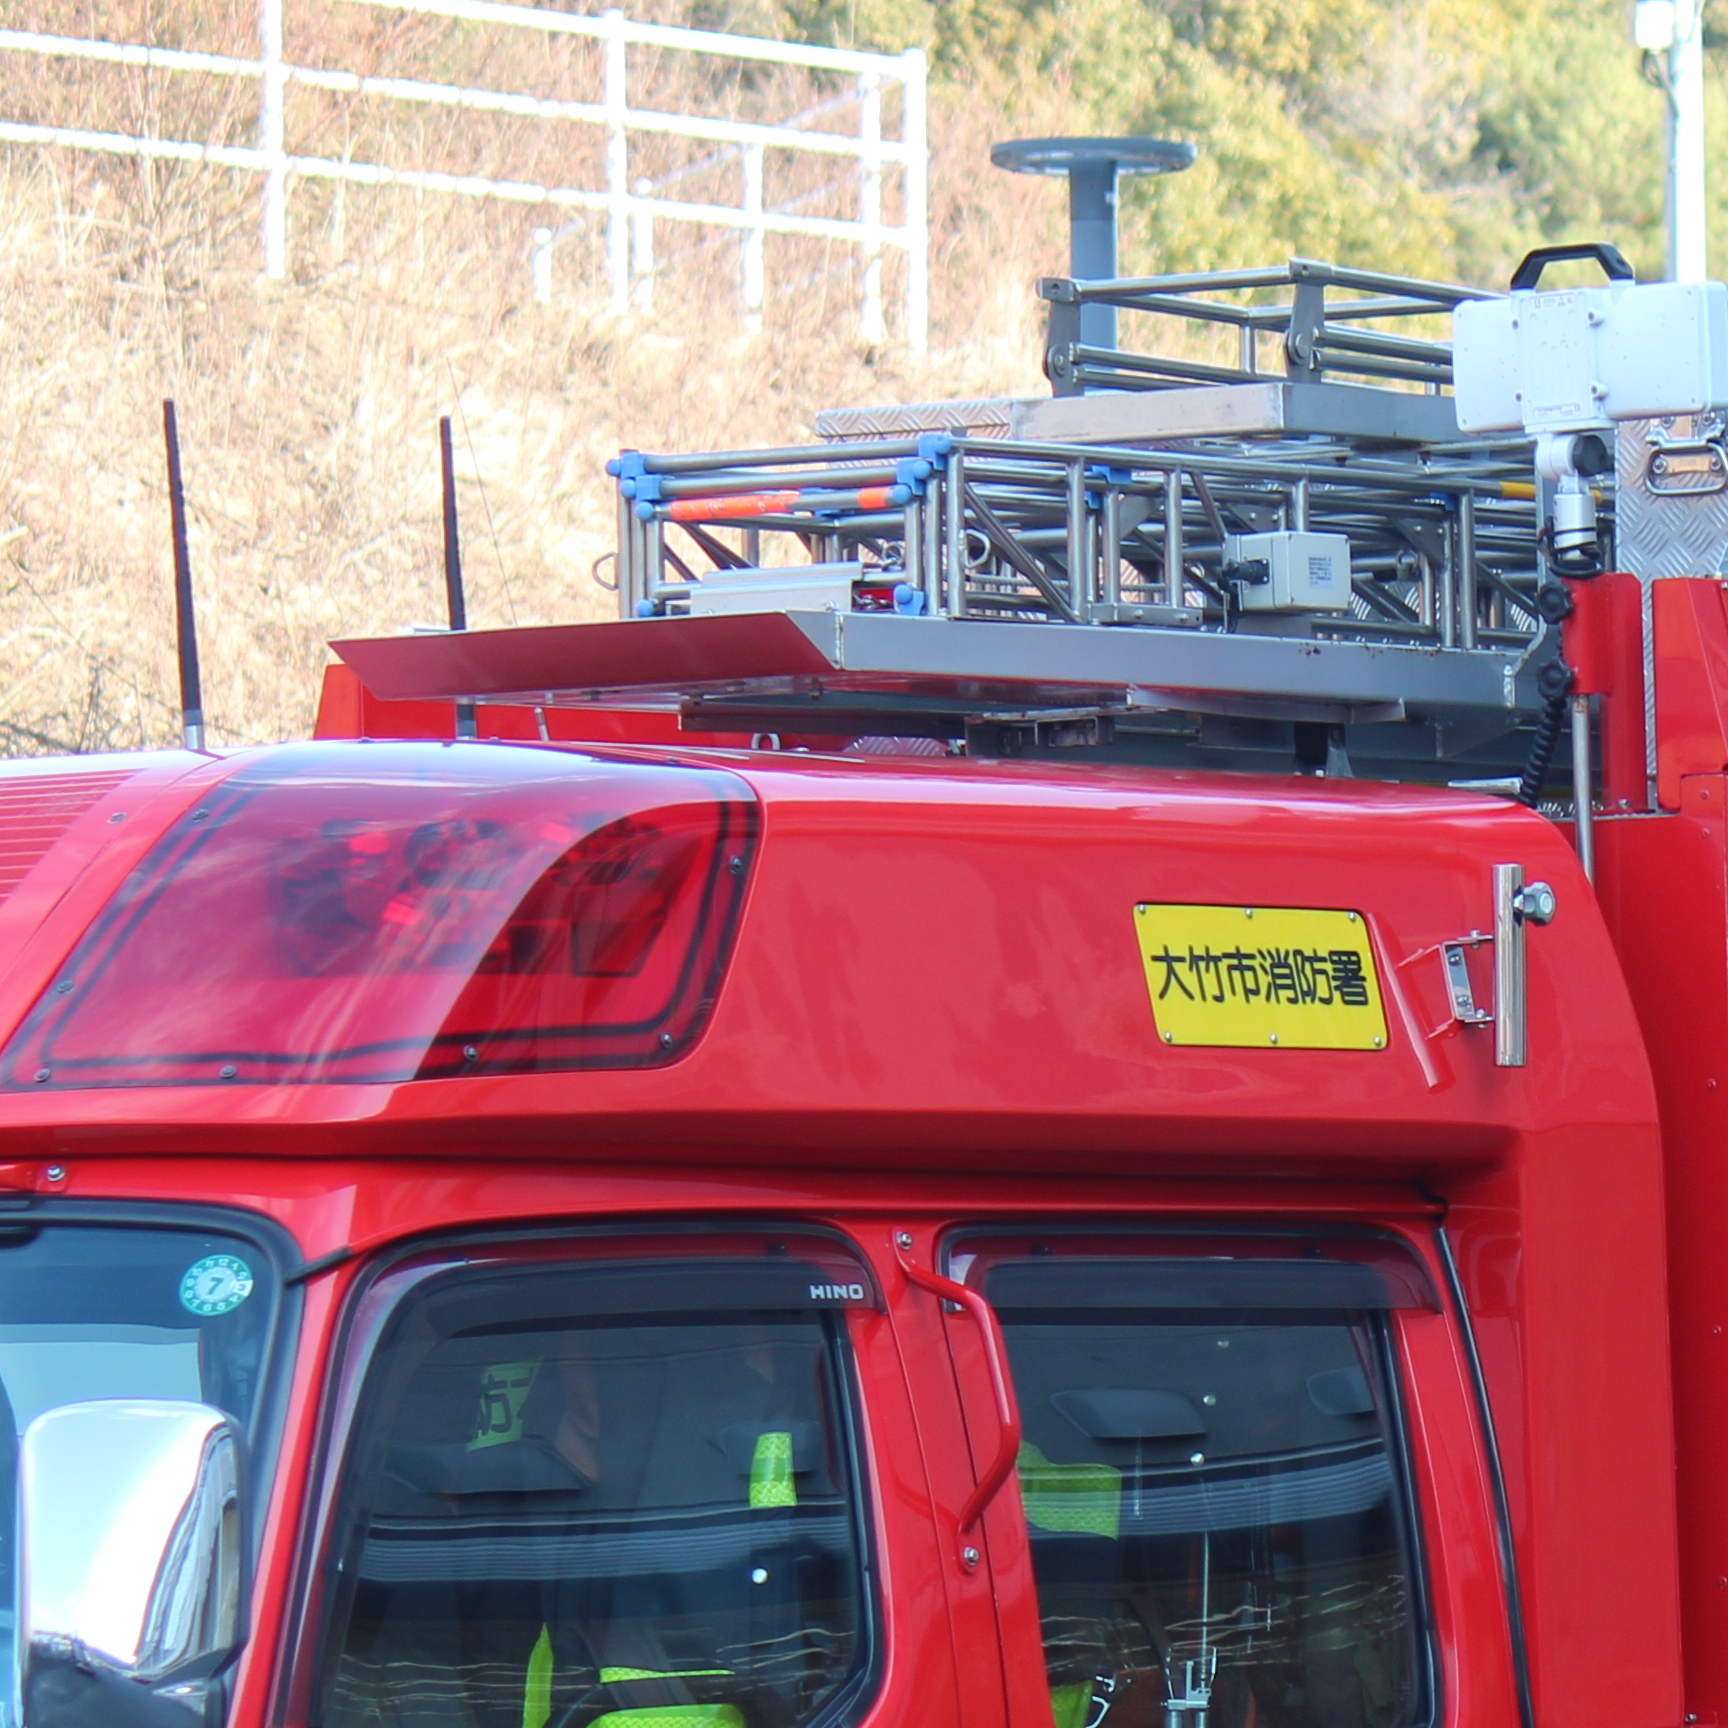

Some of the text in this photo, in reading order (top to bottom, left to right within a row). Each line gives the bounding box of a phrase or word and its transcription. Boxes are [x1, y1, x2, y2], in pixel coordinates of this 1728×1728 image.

[1149, 945, 1370, 1007] 大竹市消防署
[207, 1276, 224, 1295] 7
[809, 1284, 864, 1299] HINO
